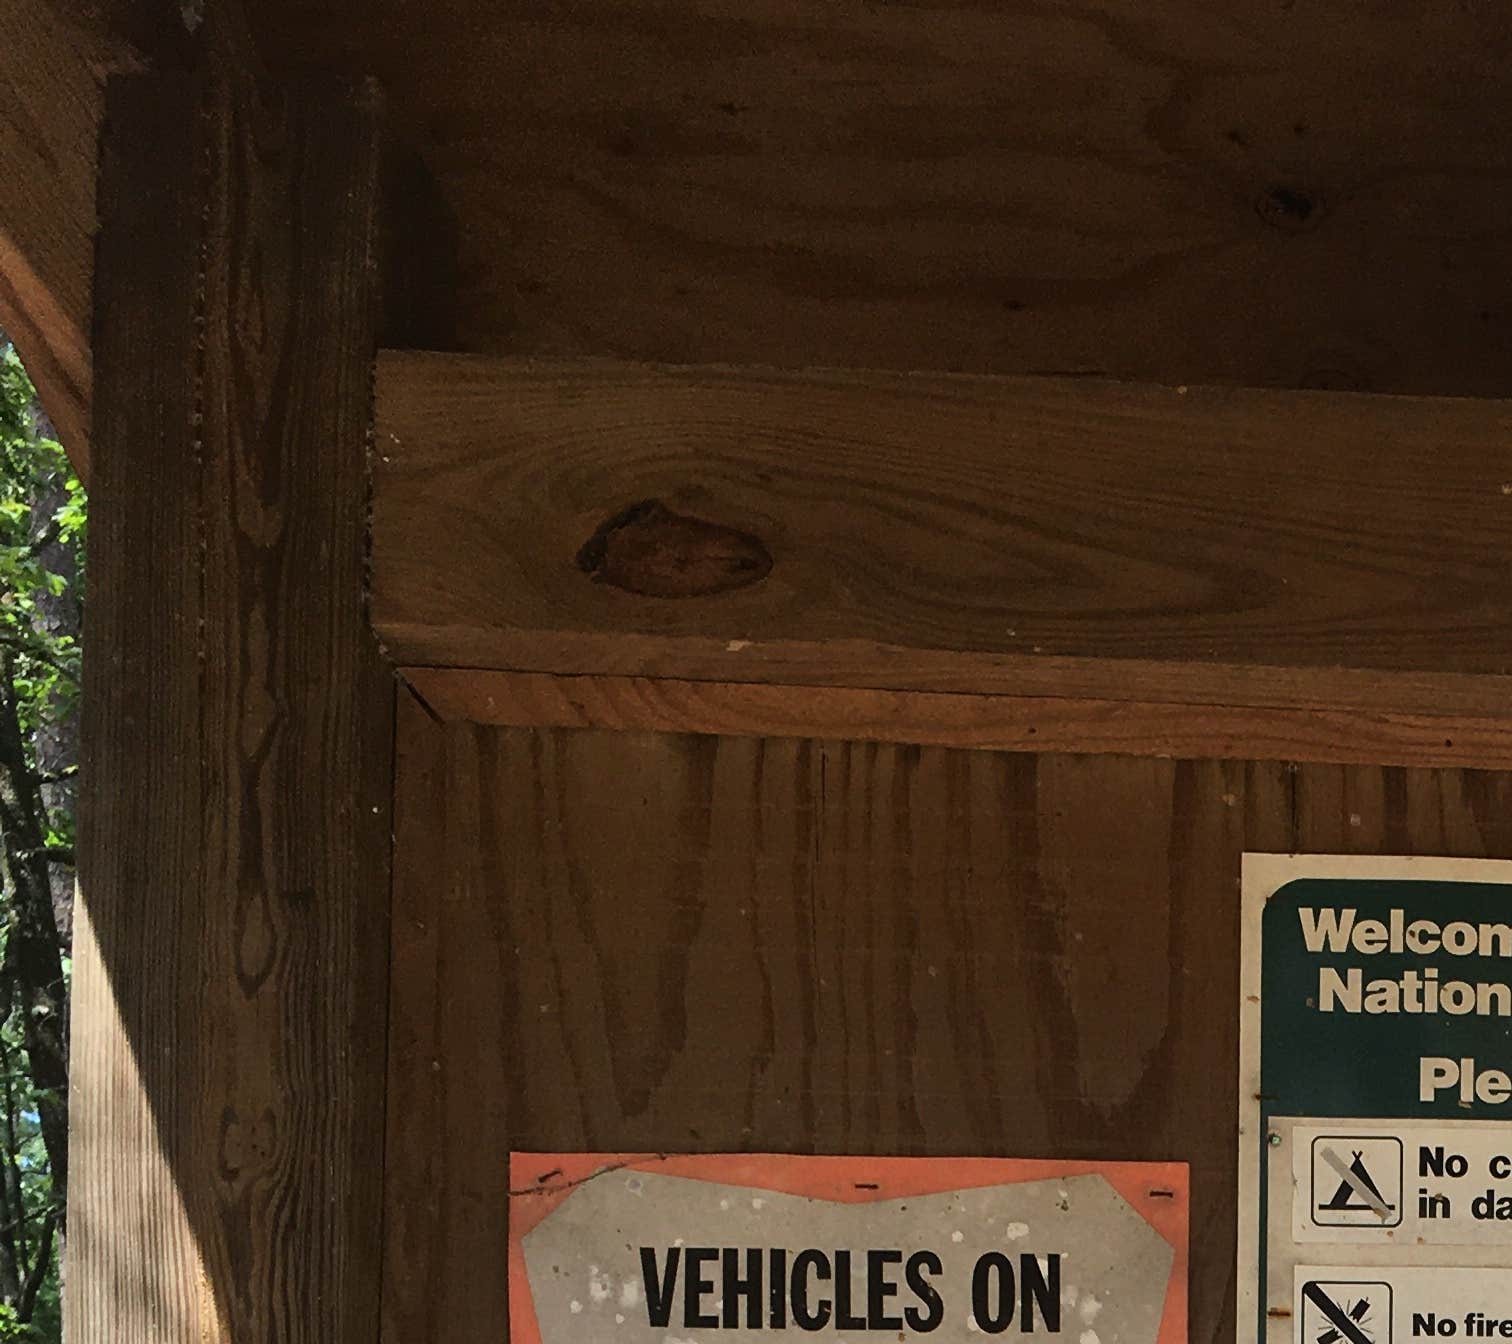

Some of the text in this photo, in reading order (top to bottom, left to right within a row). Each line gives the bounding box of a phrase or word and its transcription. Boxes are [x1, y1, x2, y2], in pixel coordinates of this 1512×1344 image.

[1419, 1146, 1468, 1177] No
[1418, 1188, 1450, 1219] in
[640, 1247, 1061, 1334] VEHICLES ON
[1412, 1313, 1456, 1337] No
